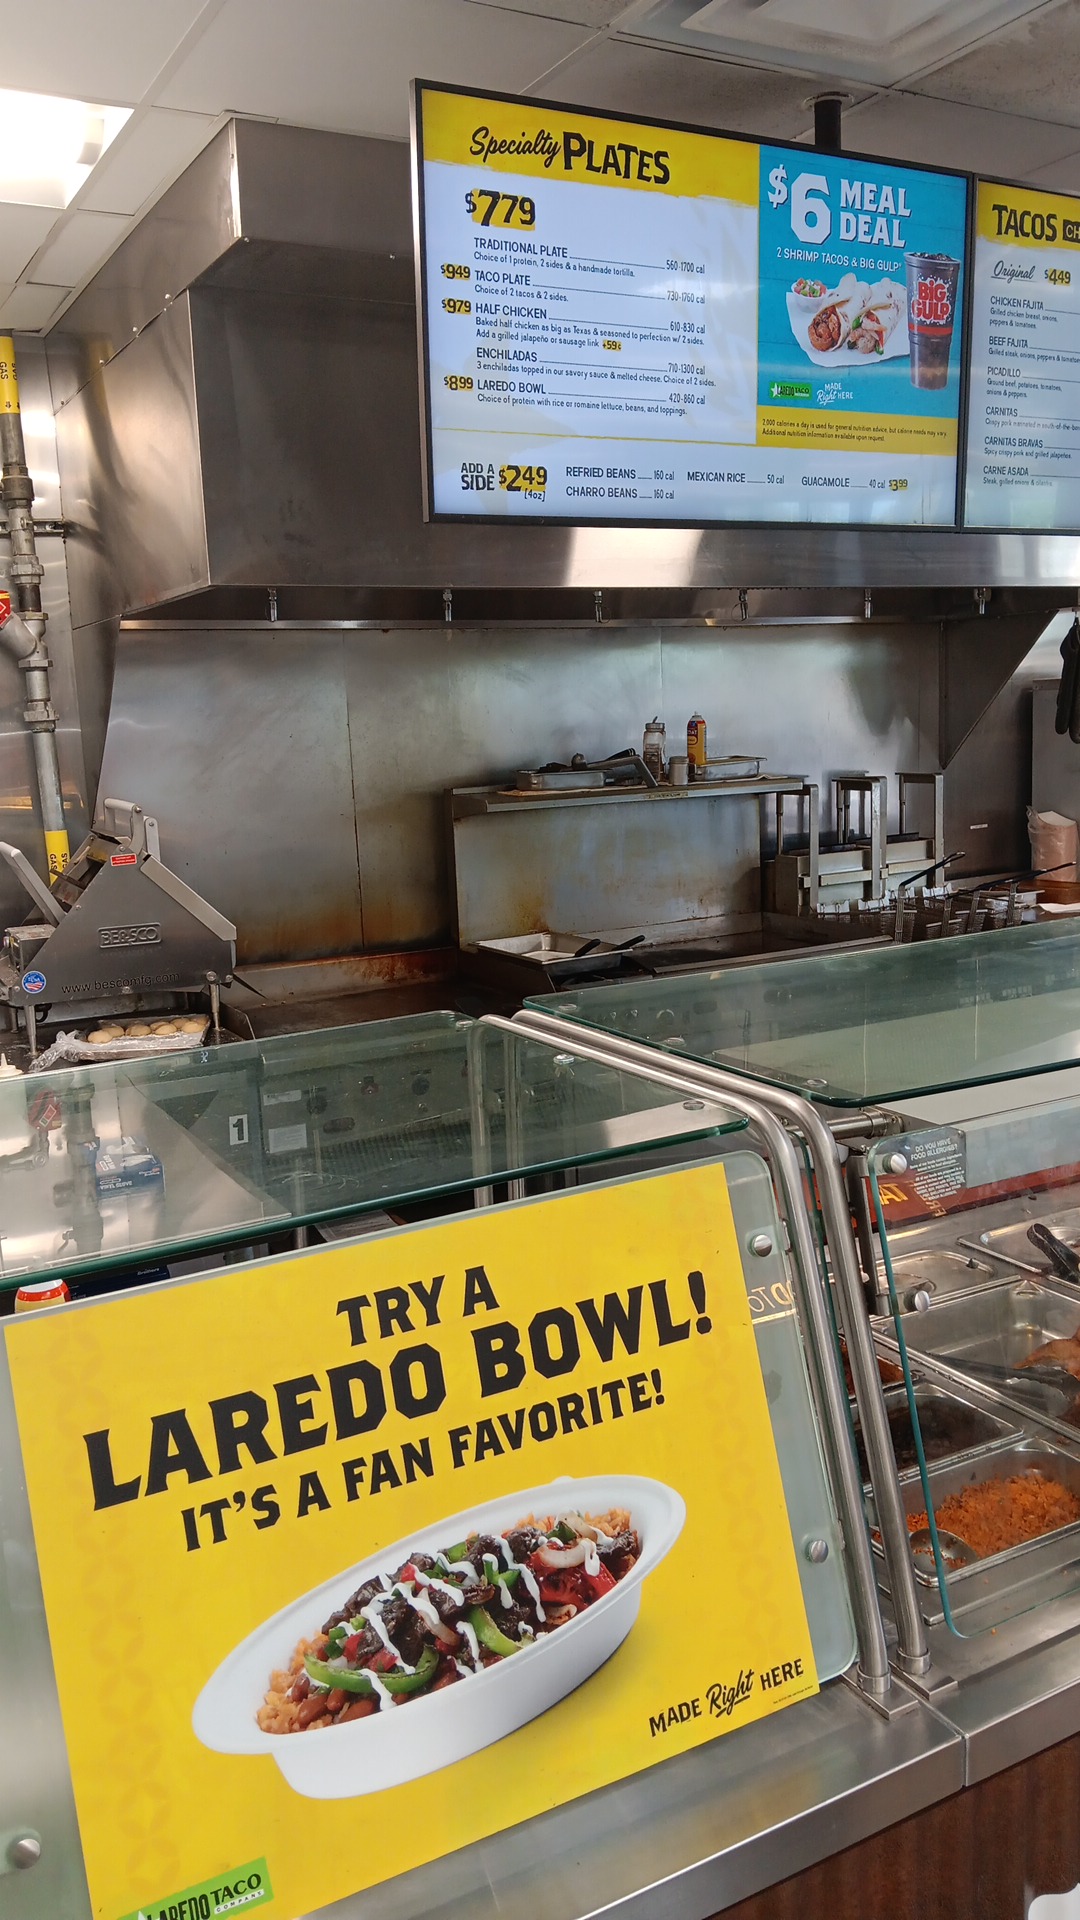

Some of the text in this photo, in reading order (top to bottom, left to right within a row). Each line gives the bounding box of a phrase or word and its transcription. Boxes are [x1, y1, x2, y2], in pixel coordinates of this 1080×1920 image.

[470, 126, 670, 185] Specialty PLATES
[767, 164, 831, 245] $6
[840, 178, 912, 218] MEAL
[465, 189, 536, 227] $779
[839, 211, 906, 249] DEAL
[992, 204, 1057, 242] TACOS
[474, 237, 568, 258] TRADITIONAL PLATE
[474, 251, 498, 261] Choice
[540, 258, 545, 267] 2
[546, 258, 563, 269] sides
[565, 262, 571, 270] &
[578, 262, 612, 275] handmade
[776, 247, 782, 258] 2
[784, 248, 819, 262] SHRIMP
[821, 250, 849, 267] TACOS
[851, 256, 858, 266] &
[859, 257, 875, 270] BIG
[440, 263, 471, 279] $949
[695, 264, 705, 274] cal
[993, 260, 1071, 285] Original $449
[474, 270, 531, 286] TACO PLATE
[474, 284, 499, 295] Choice
[501, 287, 508, 296] of
[510, 288, 514, 296] 2
[515, 290, 535, 299] tacos
[536, 291, 542, 299] &
[543, 291, 548, 299] 2
[695, 295, 705, 304] cal
[441, 298, 471, 314] $979
[475, 302, 547, 319] HALF CHICKEN
[911, 300, 951, 321] GULP
[990, 295, 1044, 310] CHICKEN FAJITA
[476, 317, 498, 327] Baked
[499, 319, 512, 328] half
[514, 320, 539, 331] chicken
[551, 324, 562, 335] big
[573, 325, 591, 335] Texas
[593, 327, 599, 335] &
[600, 328, 630, 339] seasoned
[631, 331, 638, 339] to
[639, 332, 671, 342] perfection
[682, 335, 687, 343] 2
[696, 324, 705, 334] cal
[988, 335, 1028, 348] BEEF FAJITA
[476, 346, 538, 362] ENCHILADAS
[696, 366, 705, 375] cal
[987, 366, 1021, 378] PICADILLO
[443, 375, 473, 391] $899
[477, 379, 546, 394] LAREDO BOWL
[824, 382, 842, 391] MADE
[477, 393, 501, 403] Choice
[503, 395, 510, 404] of
[511, 396, 535, 407] protein
[537, 397, 551, 406] with
[552, 398, 564, 407] rice
[574, 401, 600, 410] romaine
[647, 405, 659, 413] and
[696, 395, 705, 405] cal
[837, 391, 854, 400] HERE
[985, 405, 1018, 417] CARNITAS
[984, 436, 1044, 449] CARNITAS BRAVAS
[461, 462, 495, 475] ADD A
[566, 466, 604, 478] REFRIED
[606, 468, 636, 479] BEANS
[665, 471, 675, 481] cal
[983, 465, 1029, 477] CARNE ASADA
[461, 474, 495, 491] SIDE
[498, 464, 548, 492] $249
[687, 471, 785, 485] MEXICAN RICE 50 cal
[801, 476, 850, 487] GUACAMOLE
[877, 479, 886, 489] cal
[566, 486, 605, 498] CHARRO
[607, 487, 637, 499] BEANS
[665, 489, 675, 500] cal
[233, 1117, 245, 1141] 1
[915, 1145, 924, 1153] DO
[924, 1141, 937, 1150] YOU
[911, 1151, 926, 1161] FOOD
[336, 1265, 501, 1347] TRY A
[82, 1269, 713, 1512] LAREDO BOWL!
[296, 1470, 333, 1518] A
[341, 1435, 435, 1502] FAN
[449, 1368, 666, 1469] FAVORITE!
[648, 1697, 703, 1737] MADE
[705, 1668, 755, 1718] Right
[760, 1658, 804, 1691] HERE
[210, 1873, 262, 1906] TACO
[216, 1891, 264, 1914] COMPANY
